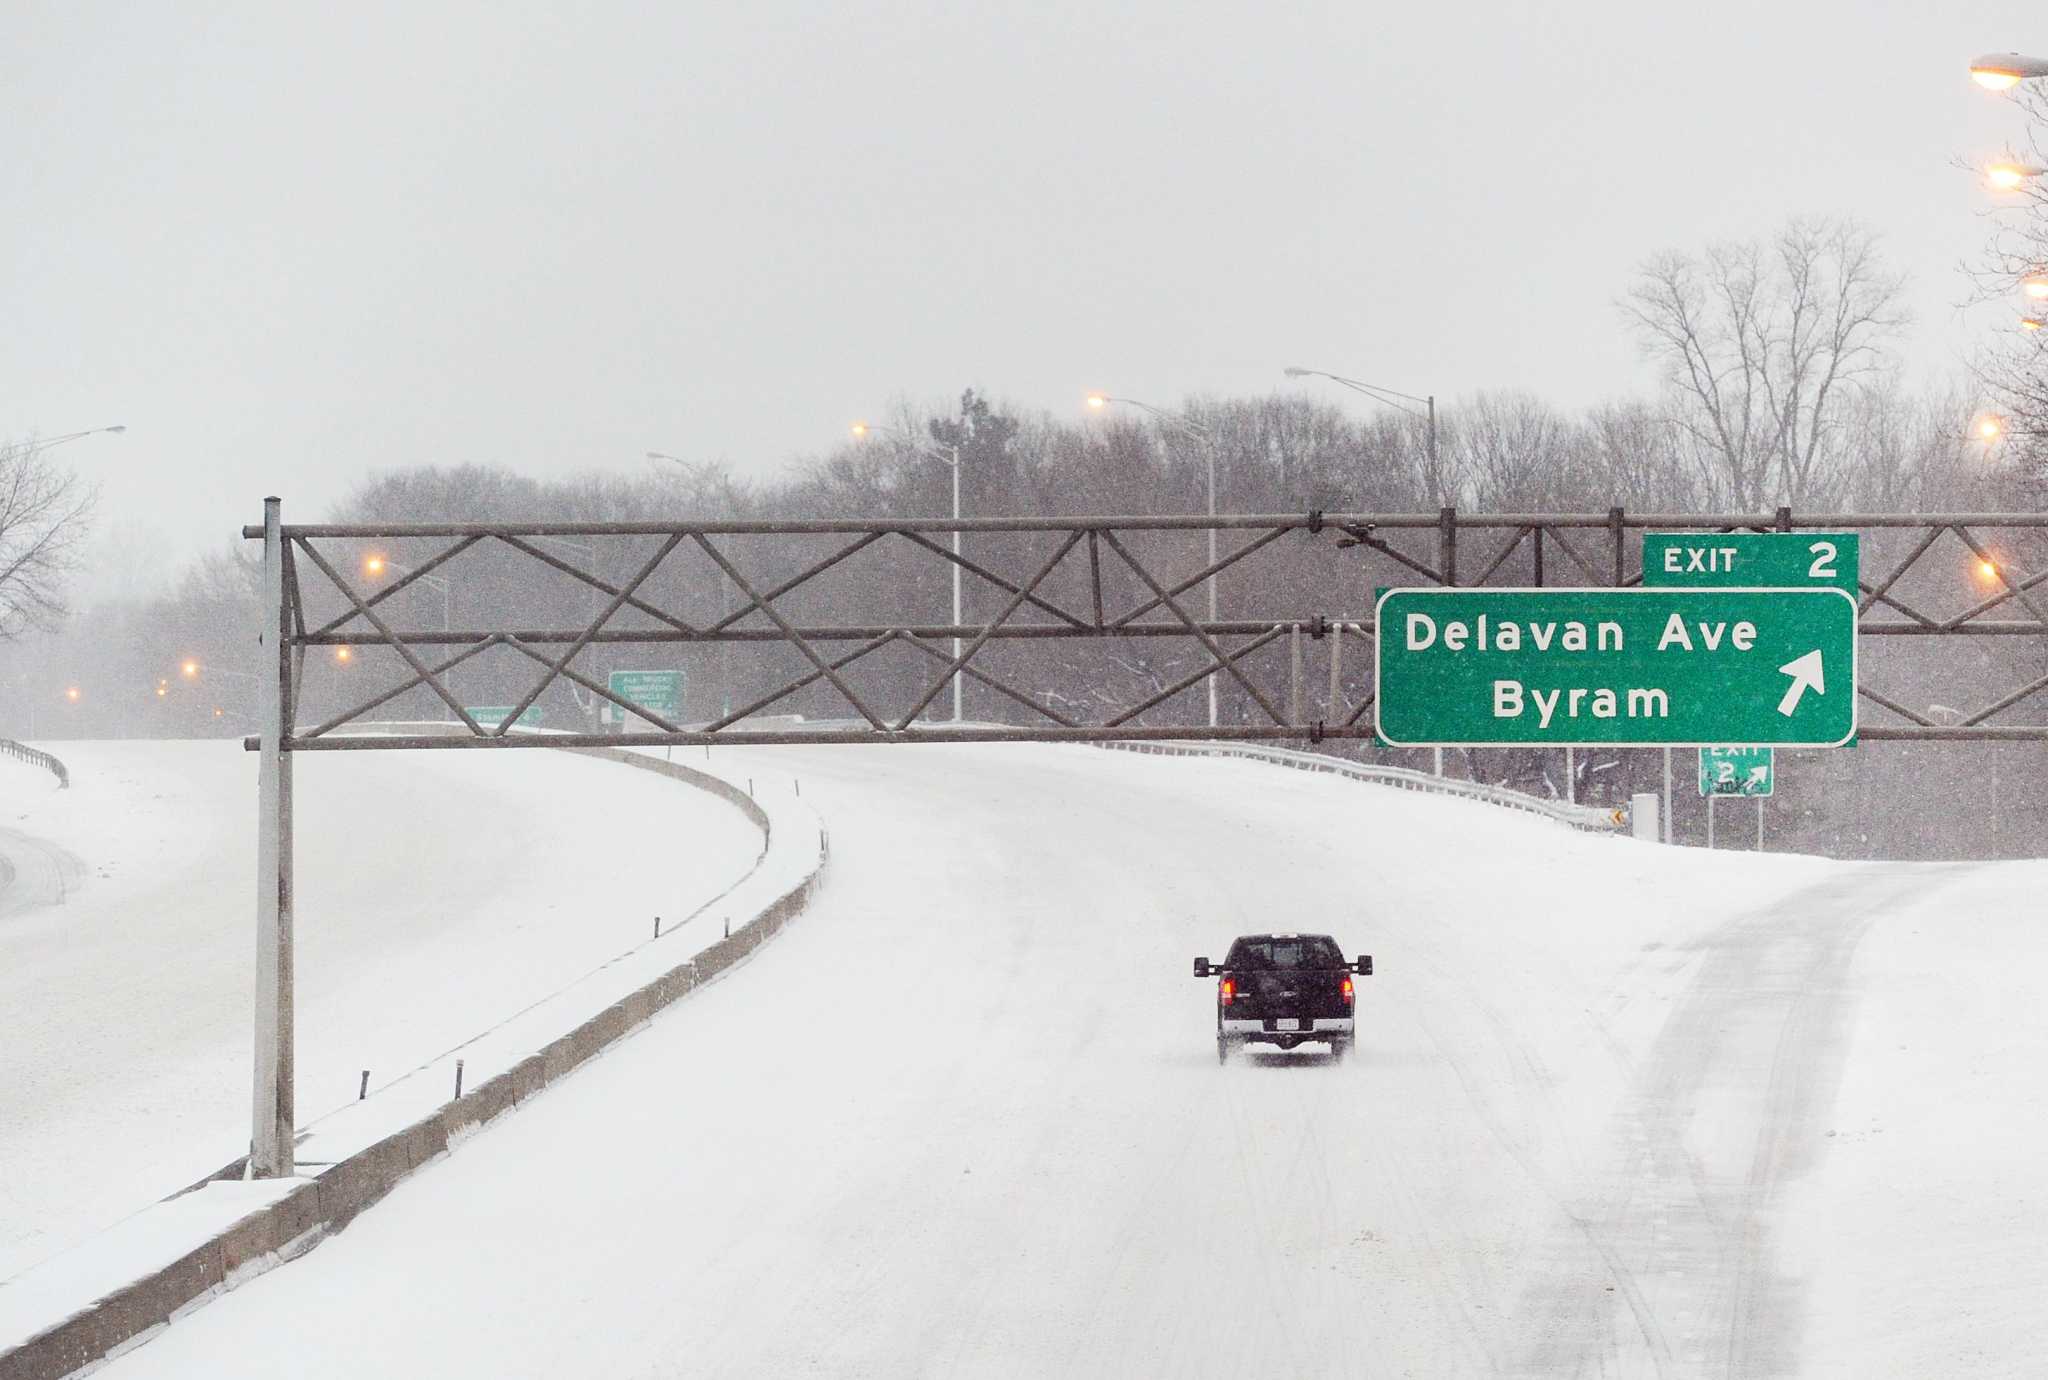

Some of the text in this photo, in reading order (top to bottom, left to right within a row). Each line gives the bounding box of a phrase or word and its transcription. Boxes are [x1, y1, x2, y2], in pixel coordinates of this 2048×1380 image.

[1665, 541, 1838, 577] EXIT 2
[1406, 613, 1757, 651] Delavan Ave
[1493, 680, 1668, 728] Byram
[1717, 761, 1735, 783] 2
